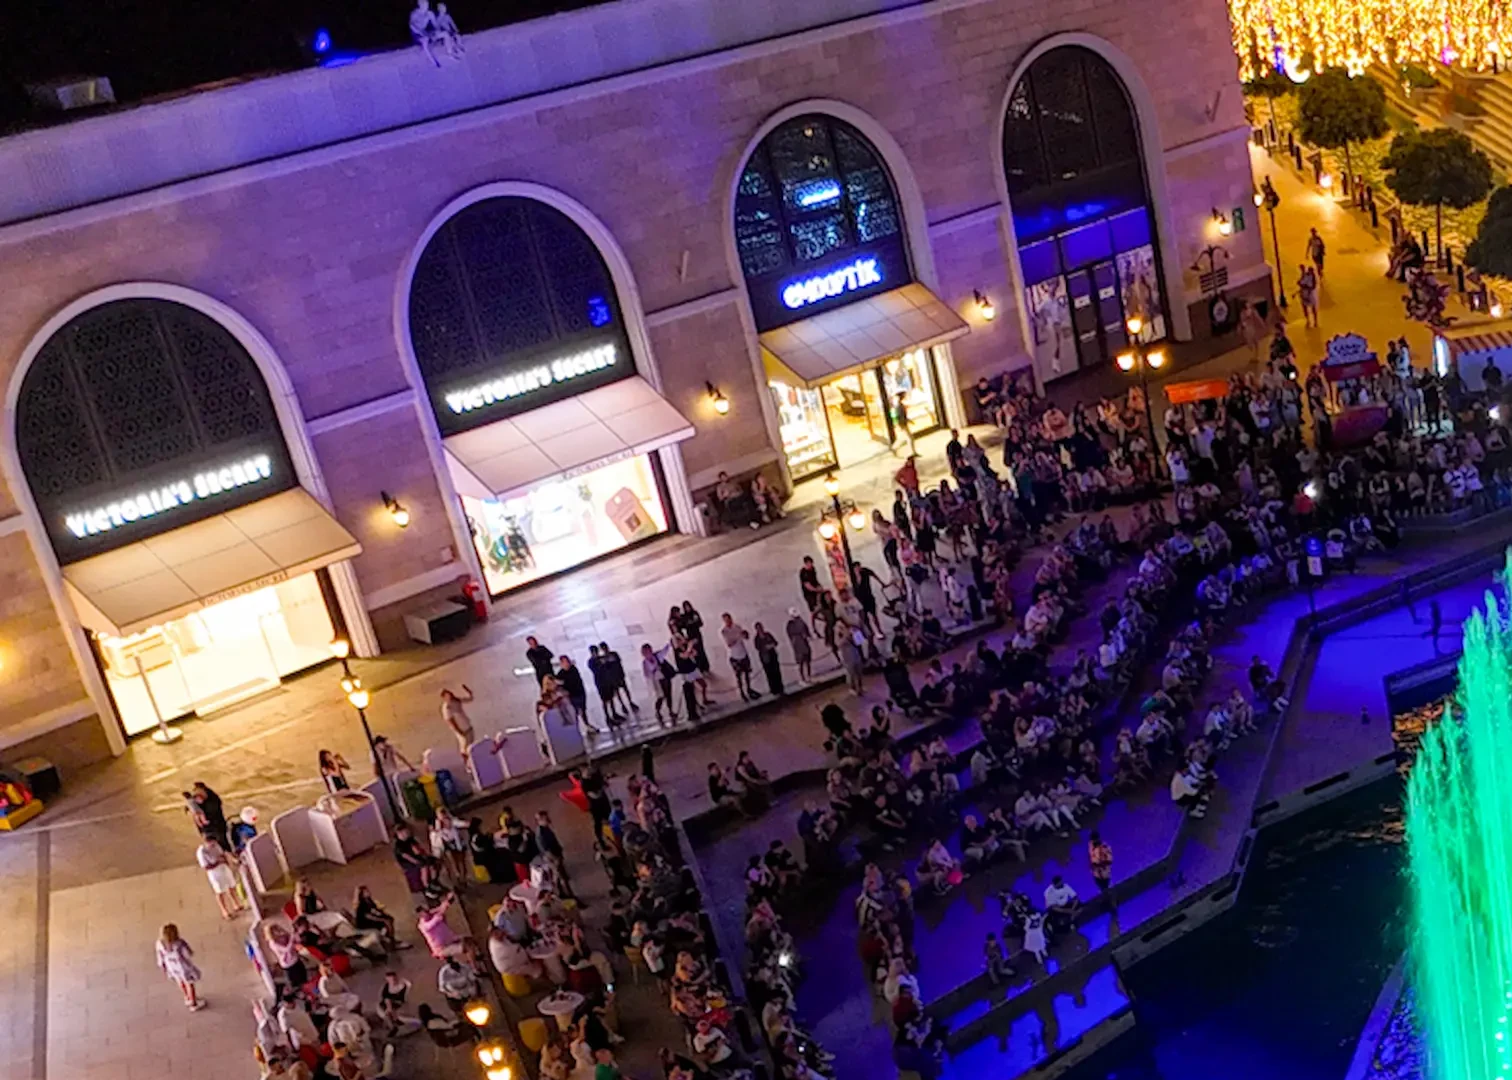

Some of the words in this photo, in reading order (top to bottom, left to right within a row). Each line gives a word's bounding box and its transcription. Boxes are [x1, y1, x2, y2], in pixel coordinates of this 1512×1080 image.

[445, 364, 551, 415] VICTORIA'S
[551, 343, 617, 383] SECRET
[65, 480, 194, 540] VICTORIA'S
[194, 453, 272, 500] SECRET
